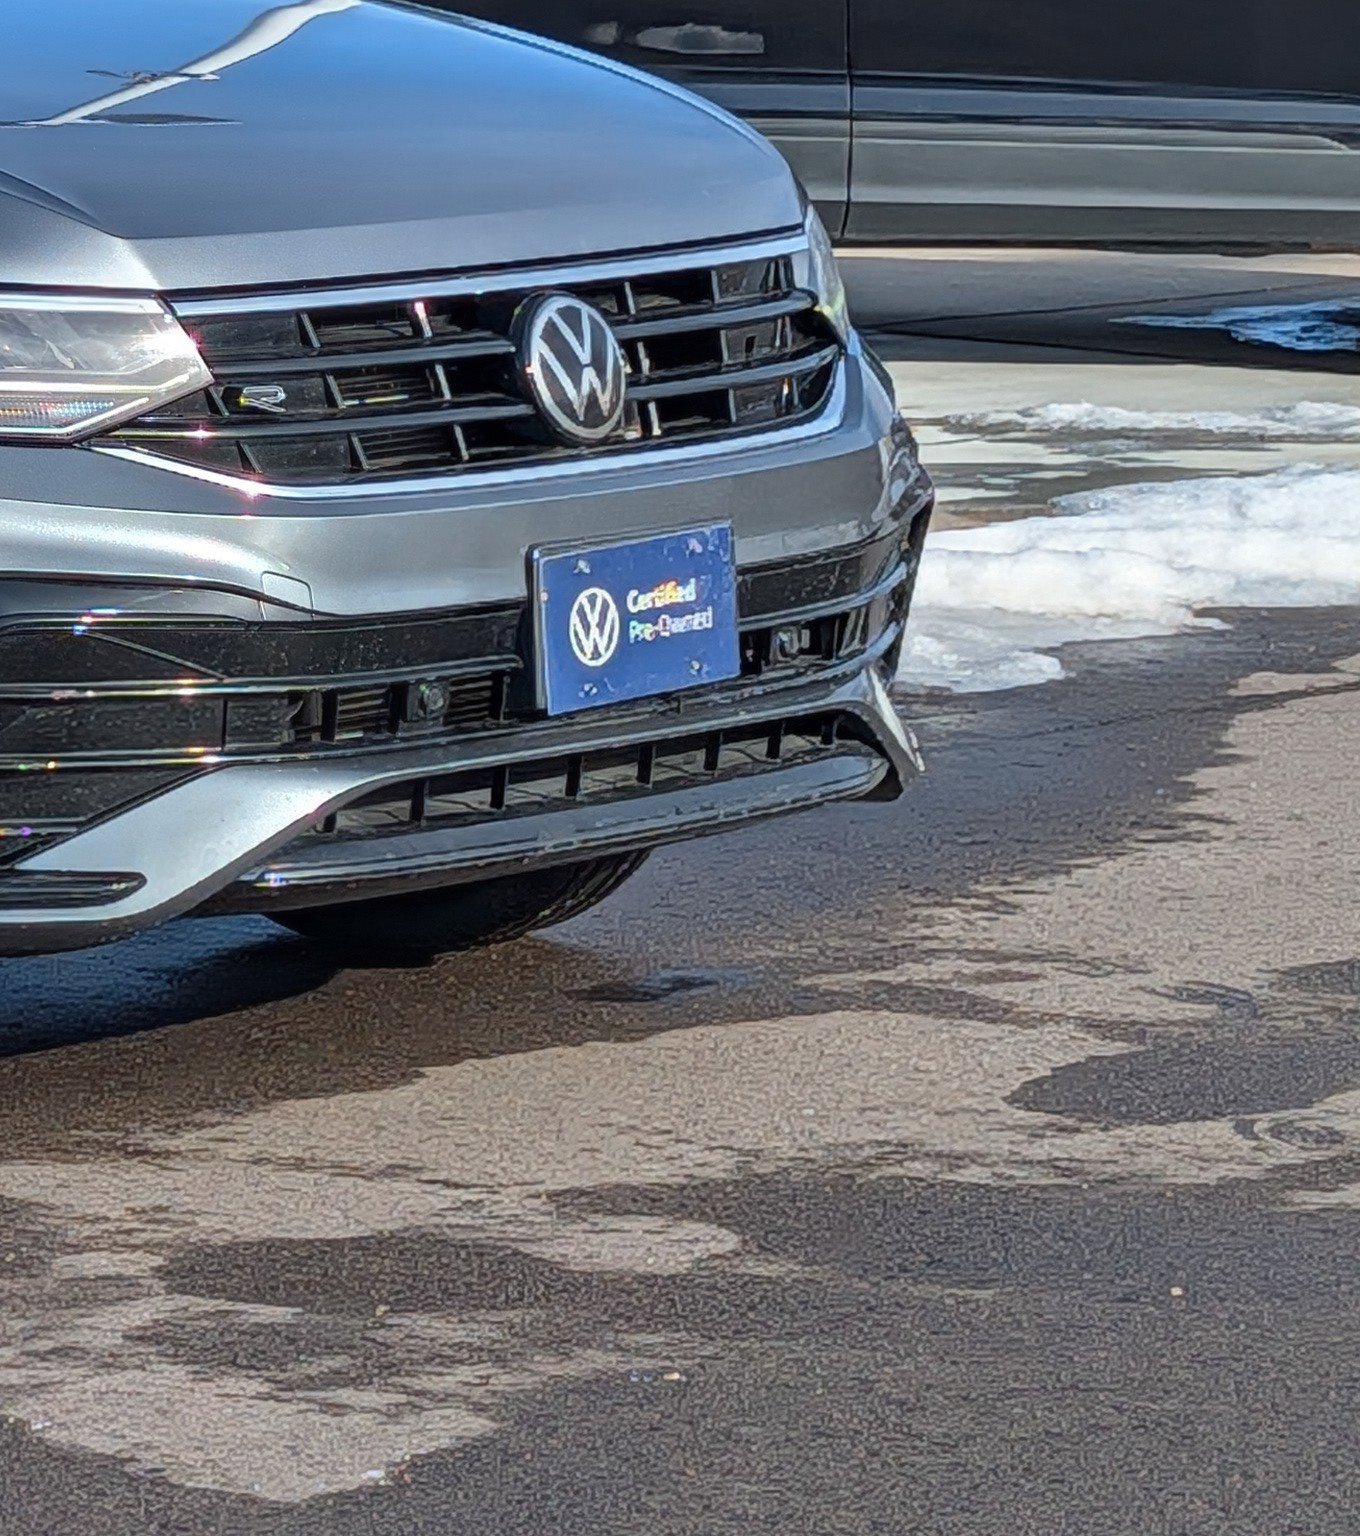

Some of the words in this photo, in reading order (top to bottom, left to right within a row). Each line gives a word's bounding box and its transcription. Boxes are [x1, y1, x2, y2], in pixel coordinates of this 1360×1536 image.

[531, 296, 625, 439] VW
[239, 385, 286, 413] R
[627, 578, 697, 613] Certified
[569, 587, 620, 667] VW
[629, 606, 714, 644] Pre-Owned
